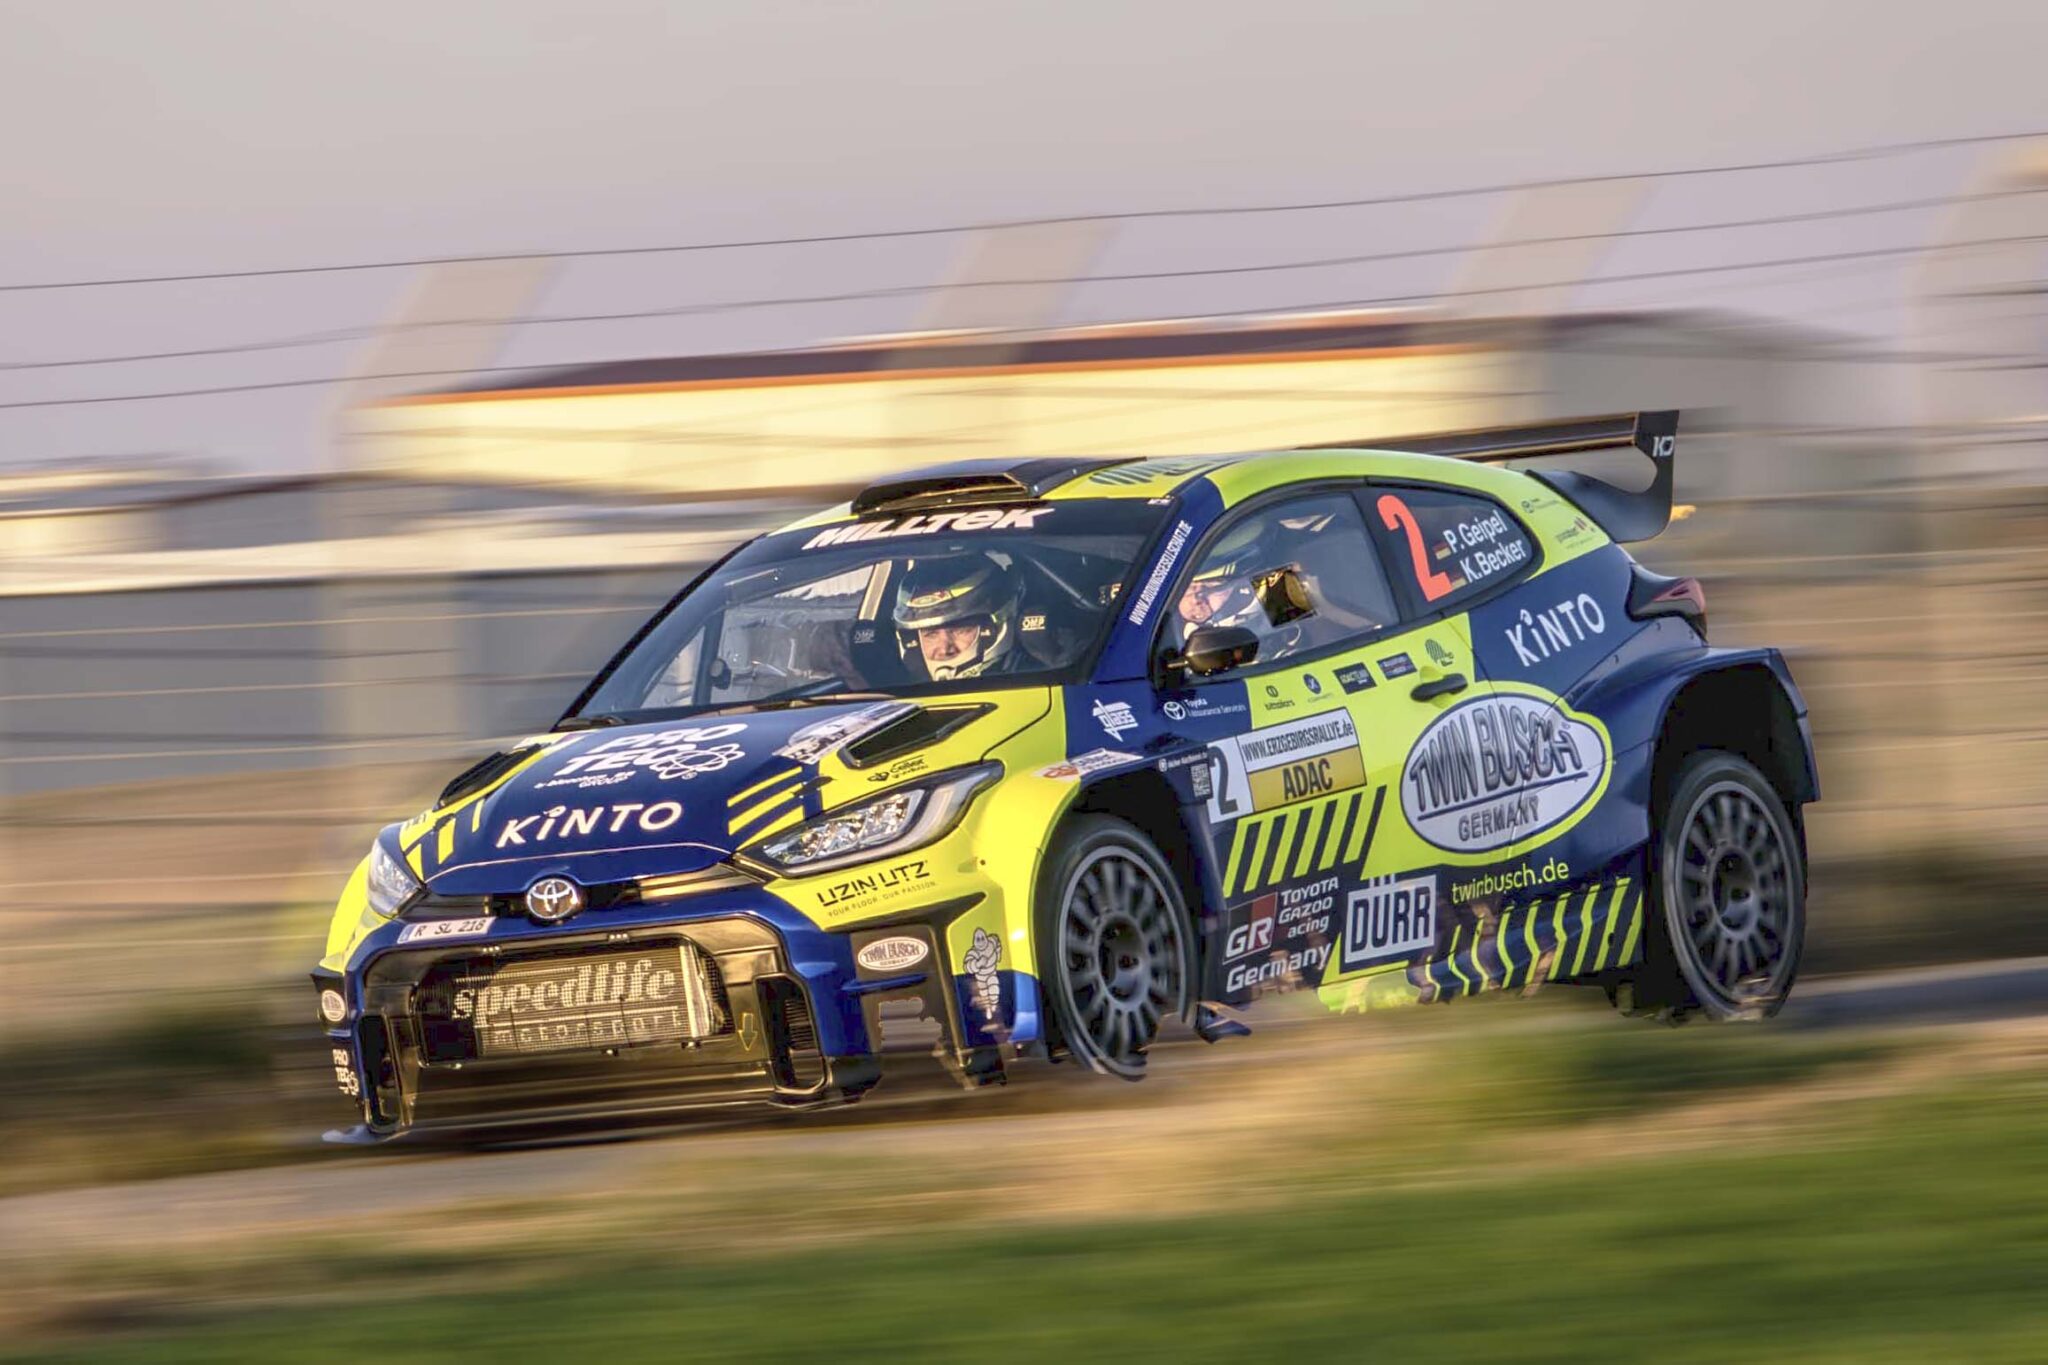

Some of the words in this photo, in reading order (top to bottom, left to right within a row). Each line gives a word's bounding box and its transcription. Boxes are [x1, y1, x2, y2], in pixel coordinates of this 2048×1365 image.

[1376, 494, 1453, 602] 2
[1459, 539, 1527, 583] K.Becker
[554, 744, 697, 776] TEC
[586, 723, 748, 755] PRO
[1409, 713, 1479, 812] TWIN
[1472, 704, 1583, 791] BUSCH
[1210, 745, 1238, 815] 2
[1282, 758, 1333, 801] ADAC
[1458, 795, 1540, 841] GERMANY
[1278, 896, 1333, 924] GAZOO
[1280, 876, 1339, 906] TOYOTA
[434, 922, 453, 935] SL
[1351, 877, 1432, 953] DÜRR
[887, 942, 921, 959] BUSCH
[1226, 917, 1273, 958] GR
[1226, 943, 1332, 993] Germany
[452, 959, 677, 1028] speedlife
